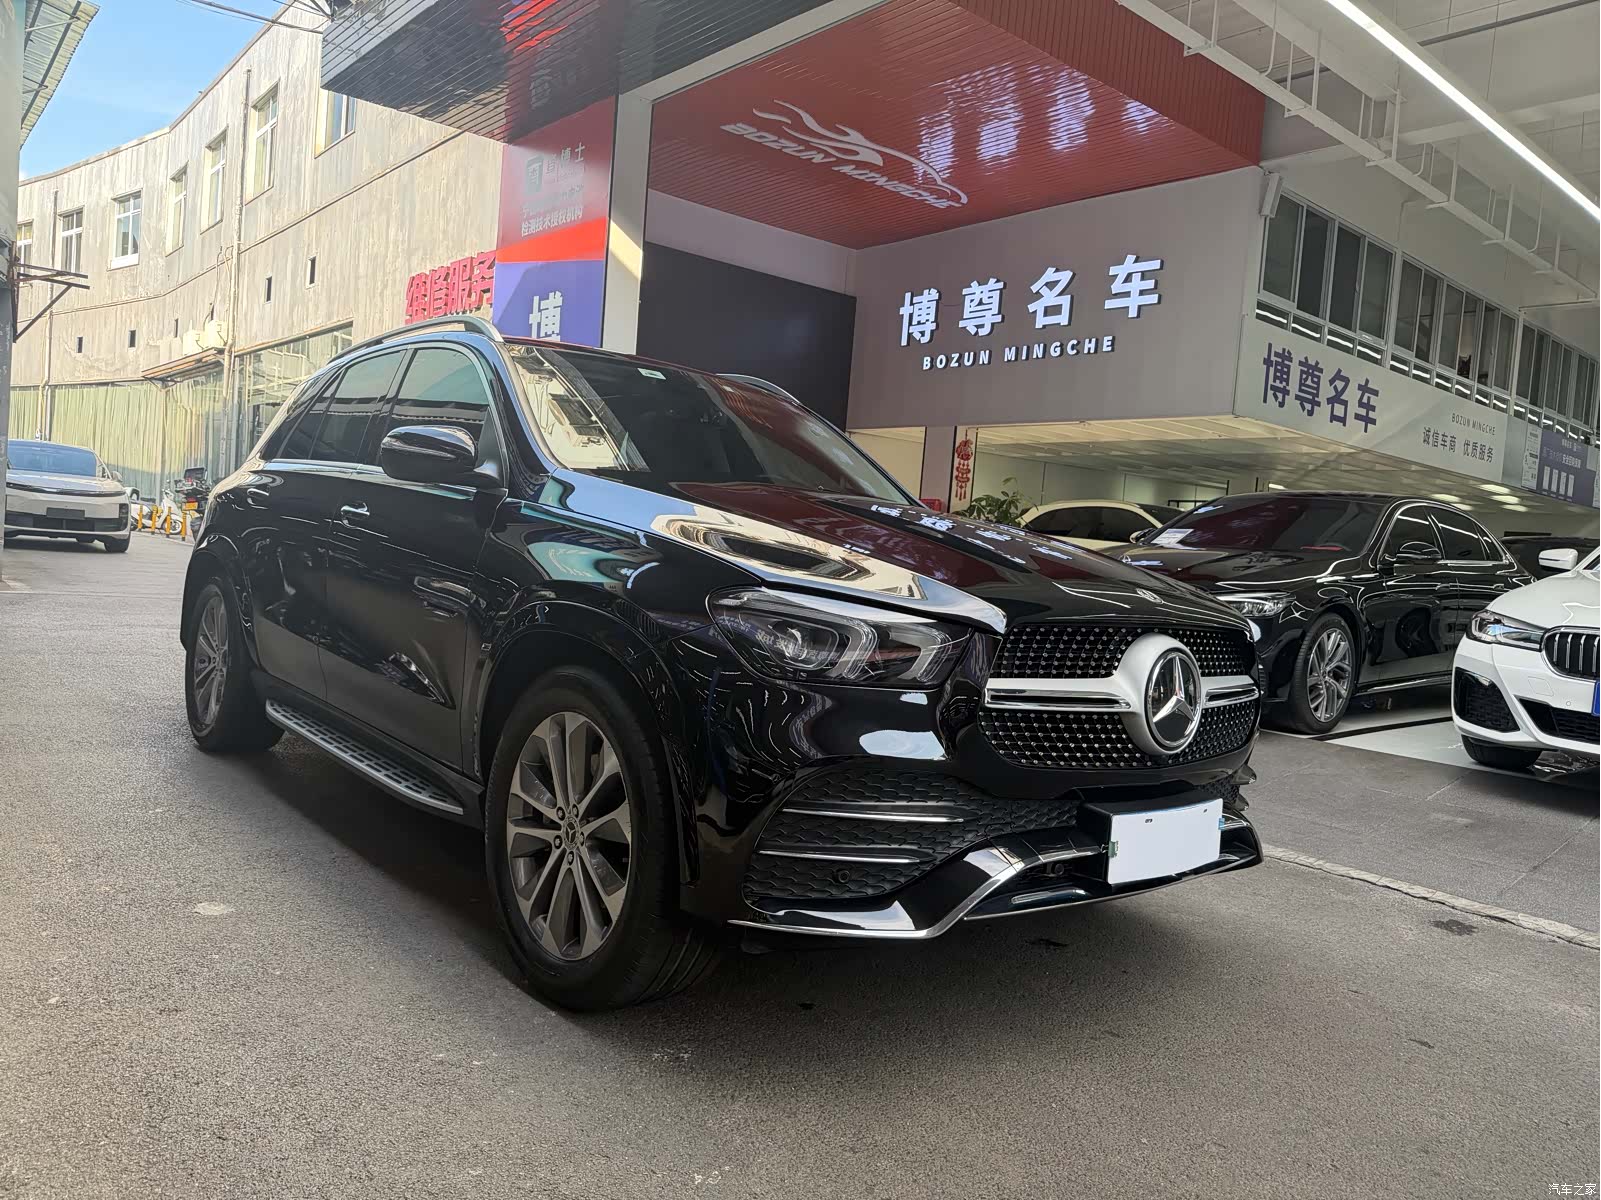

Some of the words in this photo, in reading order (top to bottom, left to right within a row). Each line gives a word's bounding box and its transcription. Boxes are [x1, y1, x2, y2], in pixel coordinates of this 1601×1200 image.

[720, 123, 837, 164] BOZUN
[832, 165, 962, 209] MINGCHE
[405, 250, 497, 326] 维修服务
[899, 254, 1163, 347] 博尊名车
[922, 350, 991, 371] BOZUN
[1003, 335, 1115, 362] MINGCHE
[1262, 342, 1380, 433] 博尊名车
[1422, 426, 1457, 453] 诚信车商
[1463, 439, 1494, 463] 优质服务
[1451, 412, 1471, 428] BOZUN
[1472, 419, 1496, 436] MINGCHE
